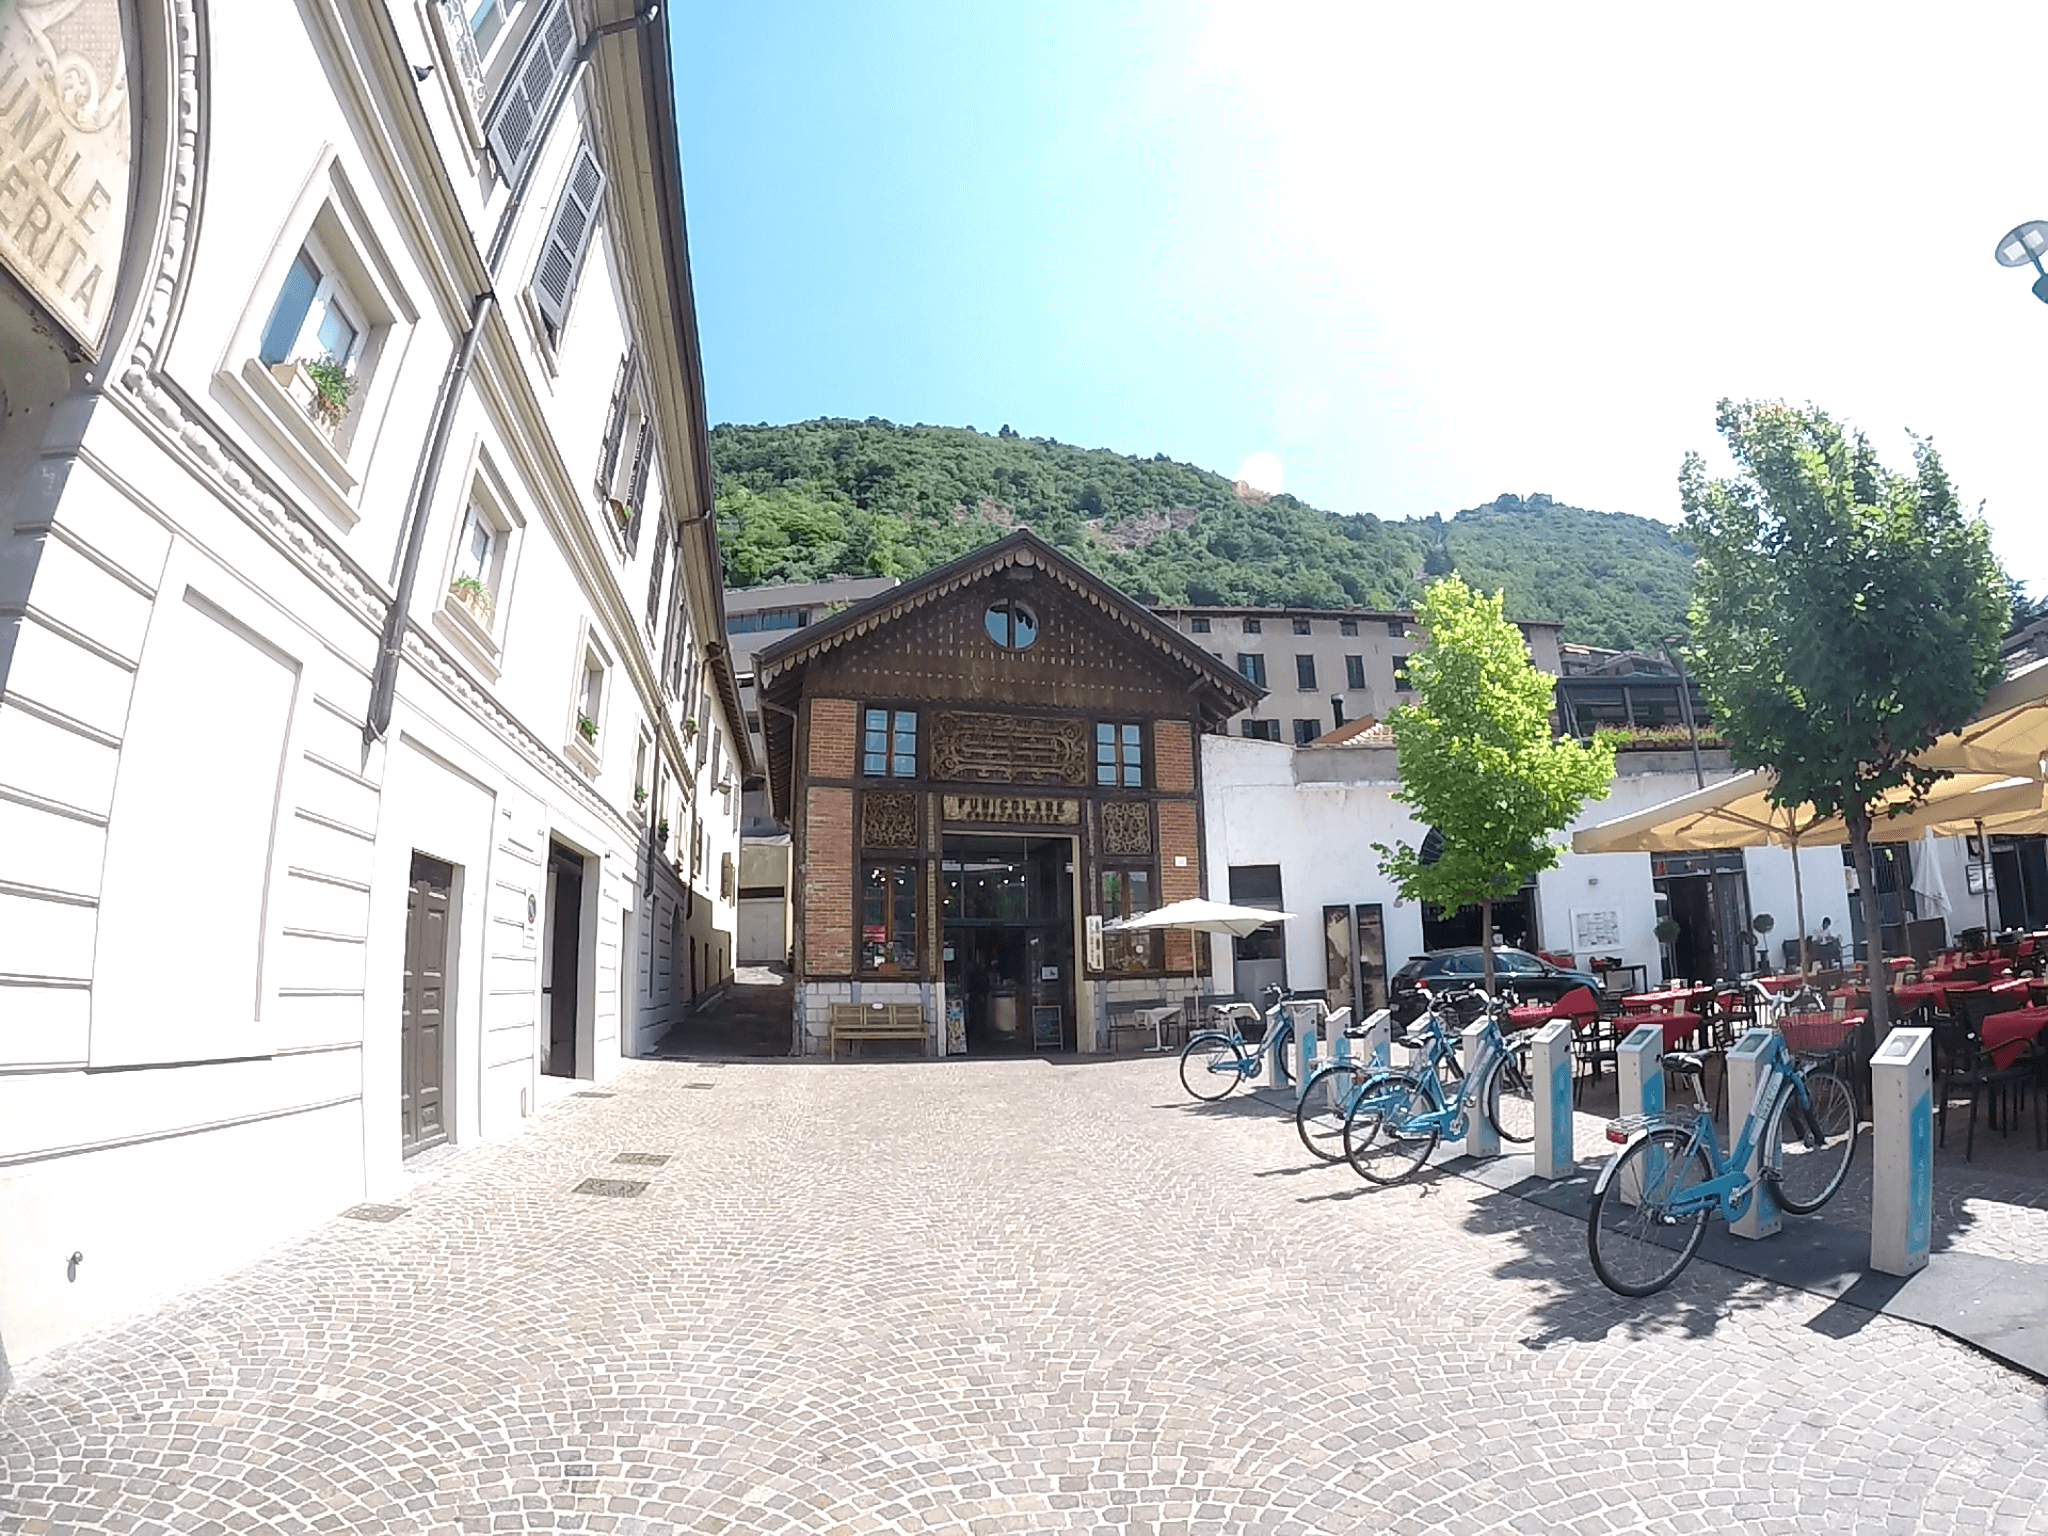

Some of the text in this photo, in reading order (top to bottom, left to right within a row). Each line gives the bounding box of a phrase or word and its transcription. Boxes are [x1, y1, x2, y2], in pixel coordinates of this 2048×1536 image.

[0, 45, 112, 236] UNALE
[0, 147, 104, 320] ERITA
[958, 797, 1066, 816] FUNICOLARE
